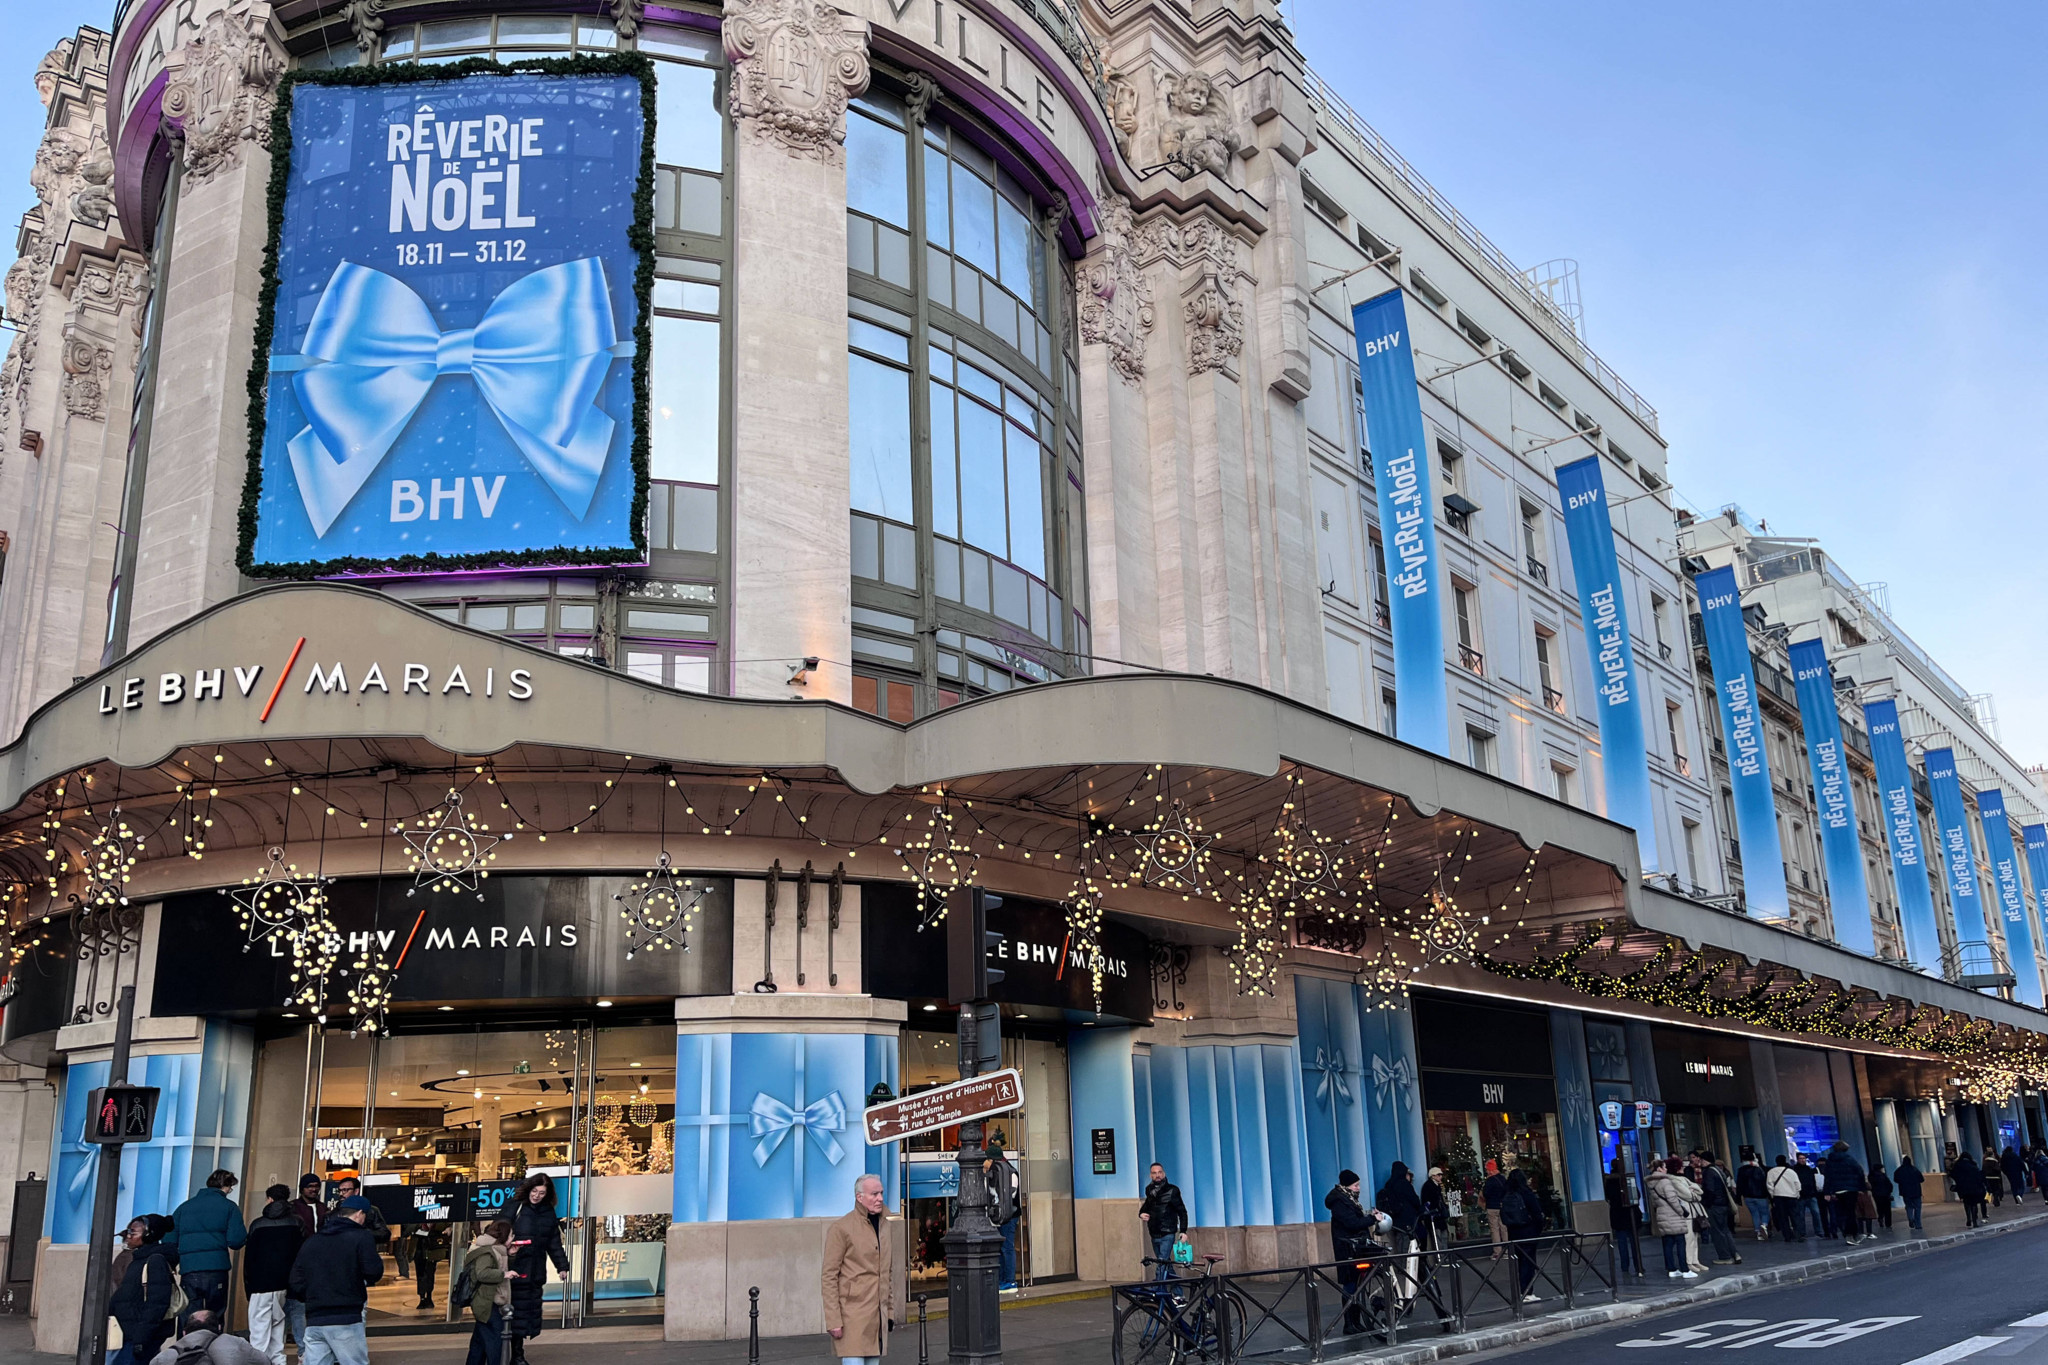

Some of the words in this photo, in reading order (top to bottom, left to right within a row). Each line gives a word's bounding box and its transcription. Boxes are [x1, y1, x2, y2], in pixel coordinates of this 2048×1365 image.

[387, 104, 544, 161] RÊVERIE
[443, 161, 461, 175] DE
[389, 153, 536, 233] NOËL
[396, 242, 443, 265] 18.11
[475, 239, 526, 262] 31.12
[1365, 331, 1400, 357] BHV
[1386, 448, 1419, 503] NOËL
[390, 475, 506, 522] BHV
[1568, 489, 1598, 510] BHV
[1393, 508, 1427, 599] RÊVERIE
[1591, 583, 1613, 629] NOËL
[1706, 594, 1733, 610] BHV
[1599, 628, 1630, 706] RÊVERIE
[1798, 667, 1823, 680] BHV
[99, 677, 144, 713] LE
[159, 665, 263, 702] BHV
[304, 661, 533, 700] MARAIS
[1726, 673, 1749, 713] NOËL
[1872, 723, 1896, 735] BHV
[1733, 713, 1760, 777] RÊVERIE
[1816, 738, 1837, 772] NOËL
[1932, 769, 1953, 780] BHV
[1822, 771, 1848, 828] RÊVERIE
[1888, 785, 1908, 816] NOËL
[1984, 809, 2002, 818] BHV
[1894, 815, 1917, 866] RÊVERIE
[2028, 841, 2045, 849] BHV
[1952, 850, 1973, 896] RÊVERIE
[424, 924, 578, 950] MARAIS
[986, 939, 1008, 958] E
[1017, 941, 1057, 965] BHV
[1685, 1062, 1694, 1073] LE
[1710, 1065, 1734, 1077] MARAIS
[898, 1101, 921, 1113] Musée
[923, 1094, 943, 1106] d'Art
[945, 1092, 953, 1100] et
[956, 1082, 992, 1097] d'Histoire
[1482, 1084, 1504, 1104] BHV
[900, 1113, 908, 1122] du
[911, 1105, 945, 1119] Judaïsme
[912, 1120, 923, 1128] rue
[926, 1116, 935, 1125] du
[937, 1108, 961, 1121] Temple
[413, 1194, 436, 1208] BLACK
[470, 1186, 516, 1208] -50%
[426, 1205, 450, 1220] FRIDAY
[594, 1248, 628, 1263] VERIE
